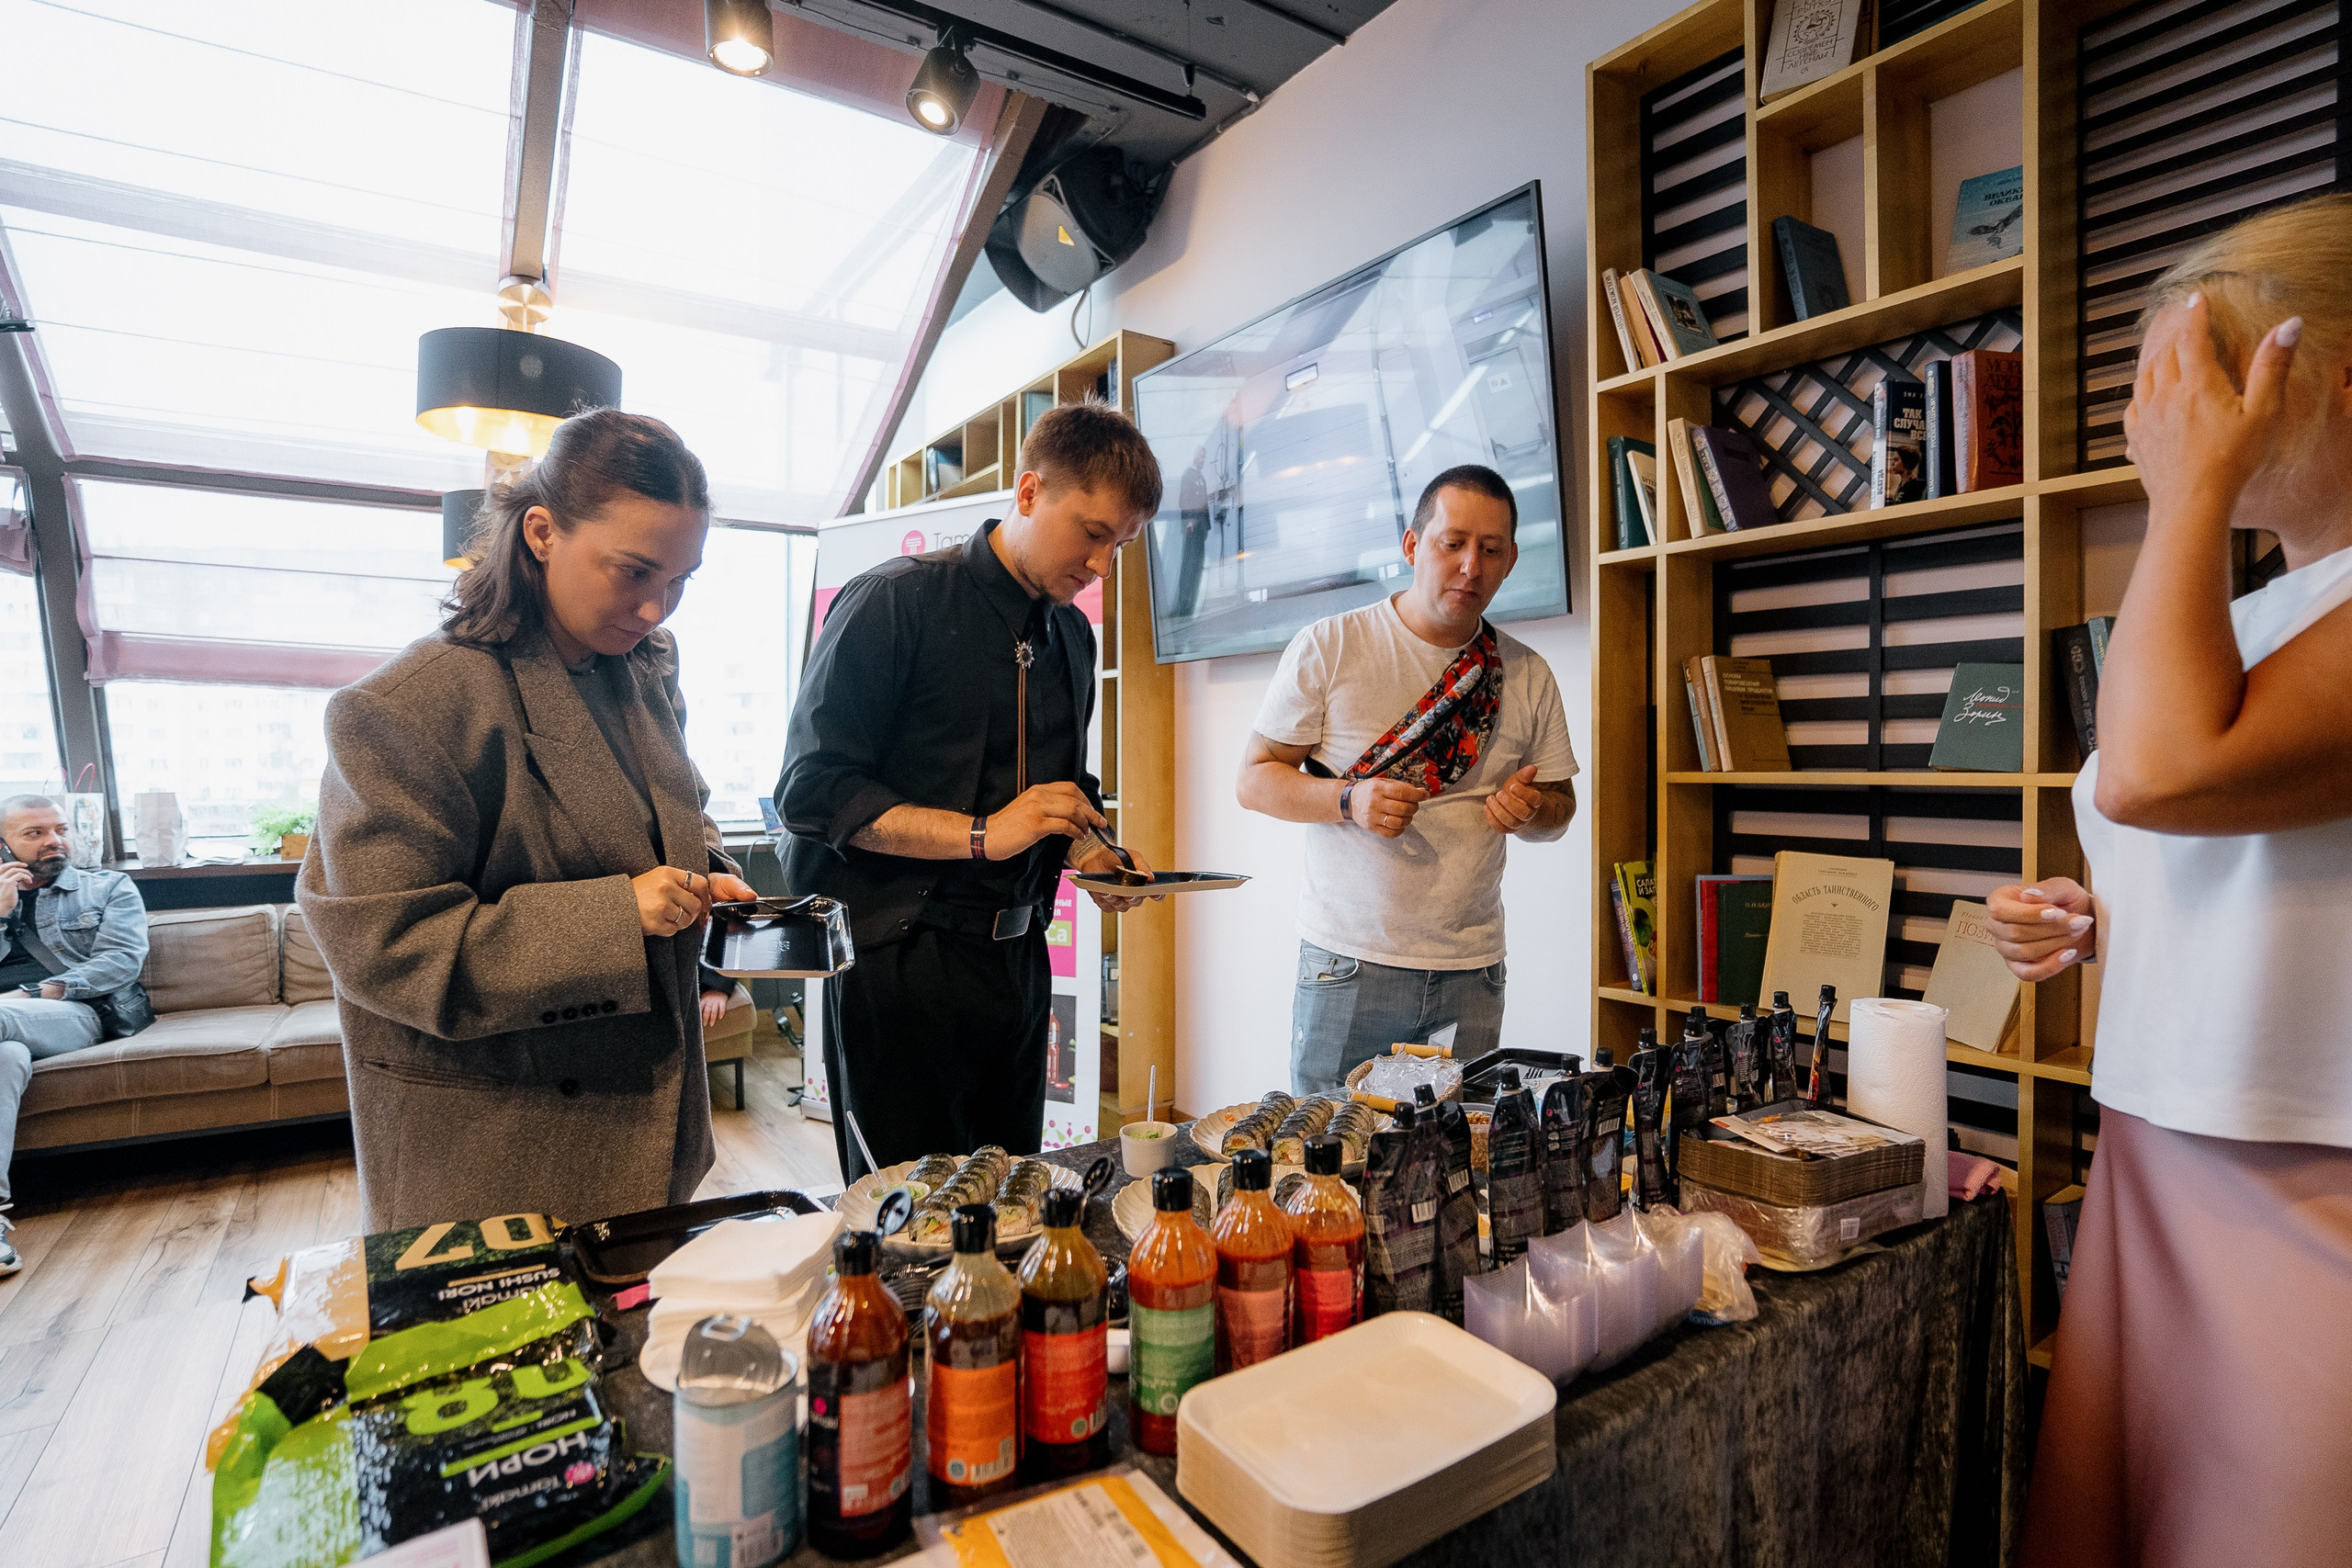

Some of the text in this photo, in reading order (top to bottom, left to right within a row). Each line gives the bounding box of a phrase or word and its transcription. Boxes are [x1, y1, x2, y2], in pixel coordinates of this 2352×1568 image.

[1796, 0, 1836, 16] РЫТХЭ
[1787, 39, 1834, 58] СОВРЕМЕН
[1787, 51, 1829, 70] ЛЕГЕНДЫ
[1894, 418, 1927, 429] СЛУЧА
[1903, 408, 1922, 420] ТАК
[1909, 430, 1927, 441] ВСЕ
[933, 532, 970, 551] Tam
[1636, 878, 1657, 888] САЛАТ
[1638, 887, 1645, 897] И
[1055, 898, 1072, 908] НЫЕ
[1792, 885, 1880, 912] ОБЛАСТЬ ТАИНСТВЕННОГО
[1046, 923, 1069, 943] Ca
[1955, 920, 1995, 942] ПОЗИ
[395, 1213, 556, 1271] 07
[437, 1267, 561, 1302] SUSHI NORI
[462, 1287, 542, 1314] amaki
[467, 1430, 589, 1488] НОРИ
